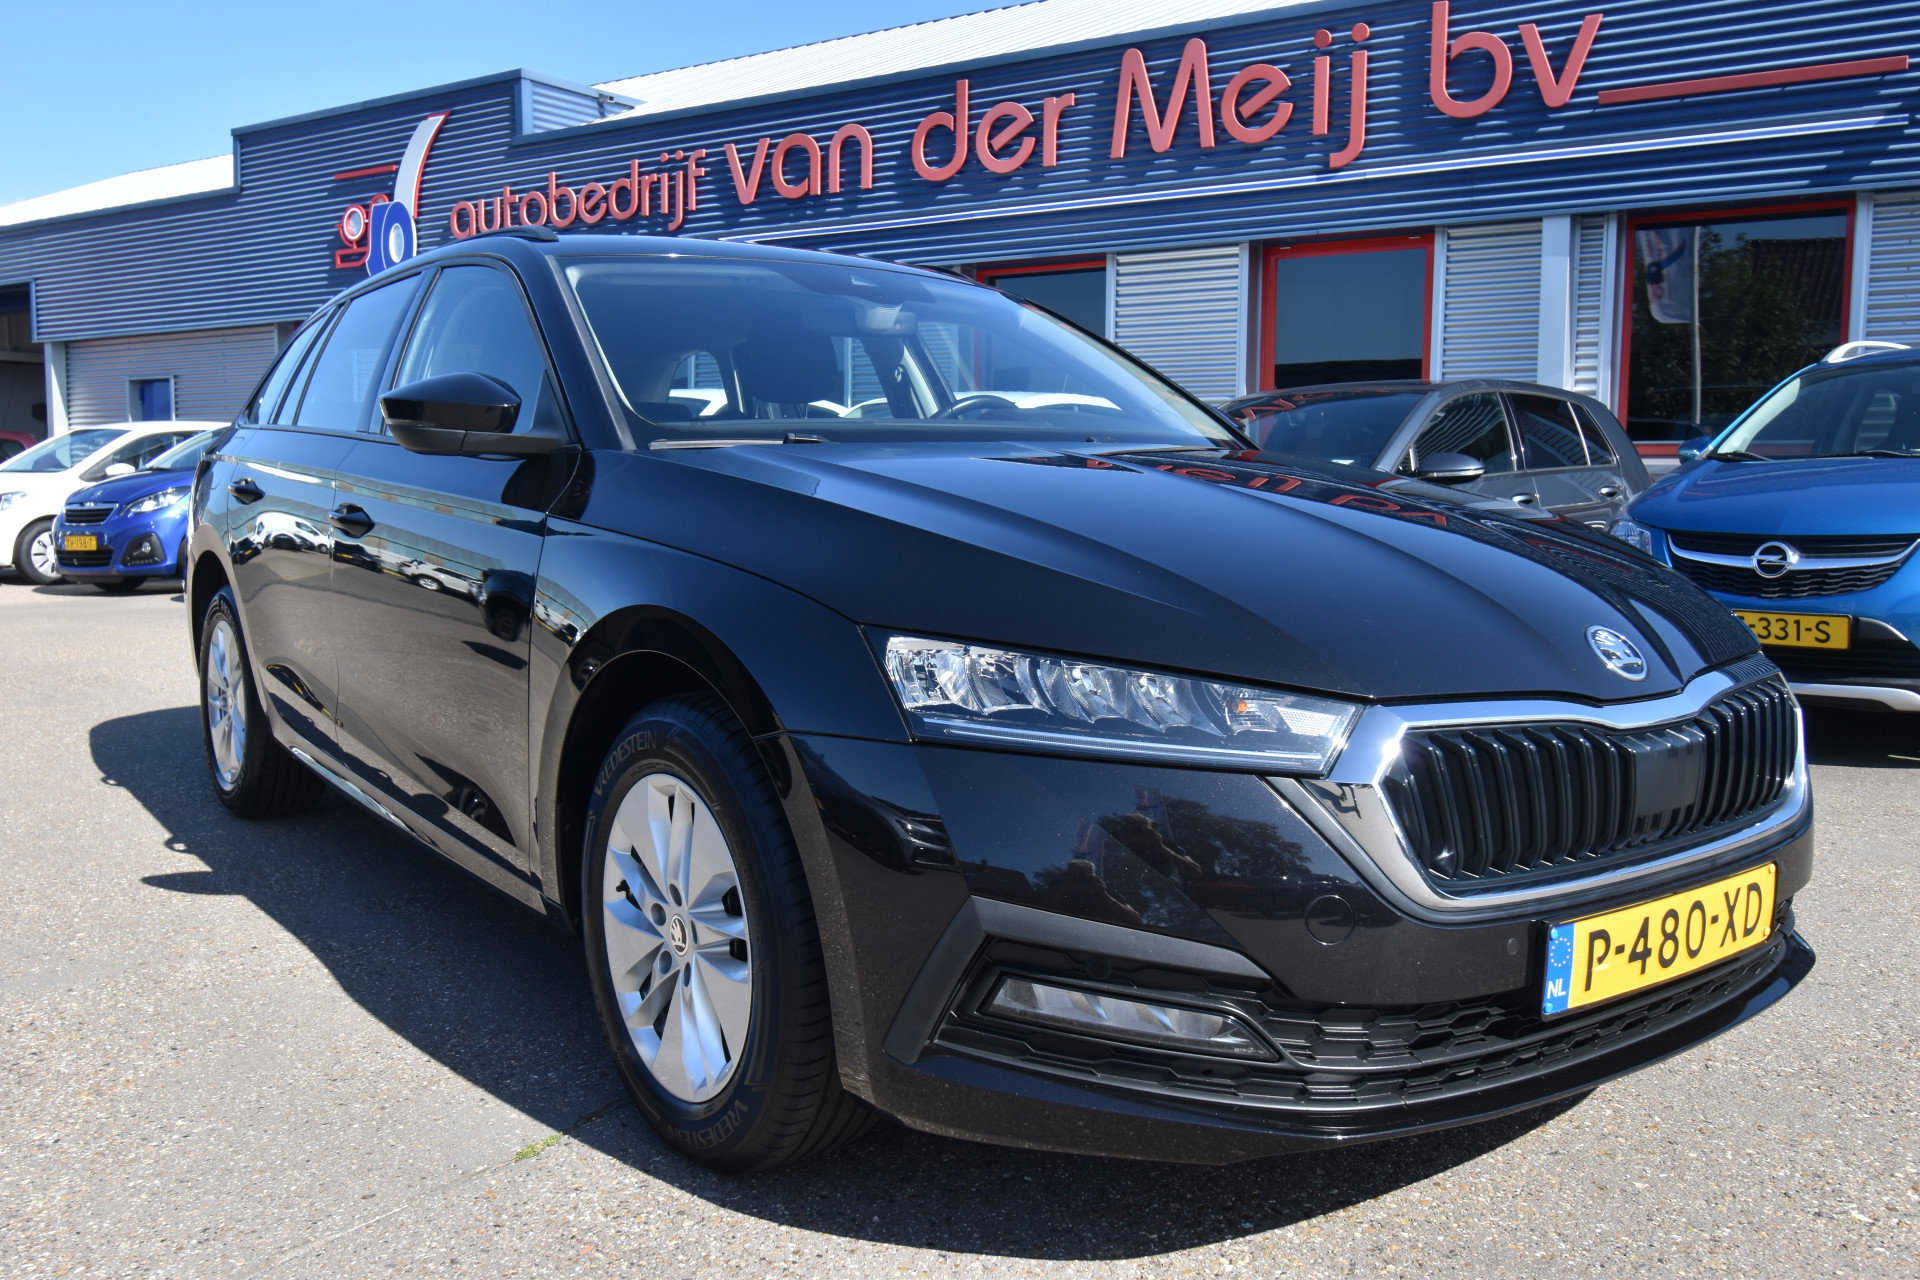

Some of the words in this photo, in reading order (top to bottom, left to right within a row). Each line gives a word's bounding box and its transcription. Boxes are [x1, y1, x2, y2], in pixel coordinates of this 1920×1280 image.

[450, 148, 706, 240] autobedrijf
[724, 123, 873, 205] van
[911, 78, 1075, 182] der
[1110, 22, 1371, 168] Meij
[1429, 0, 1603, 118] bv
[1739, 615, 1831, 644] -331-S
[593, 729, 657, 798] VREDESTEIN
[1584, 881, 1763, 992] P-480-XD
[1546, 978, 1567, 1000] NL
